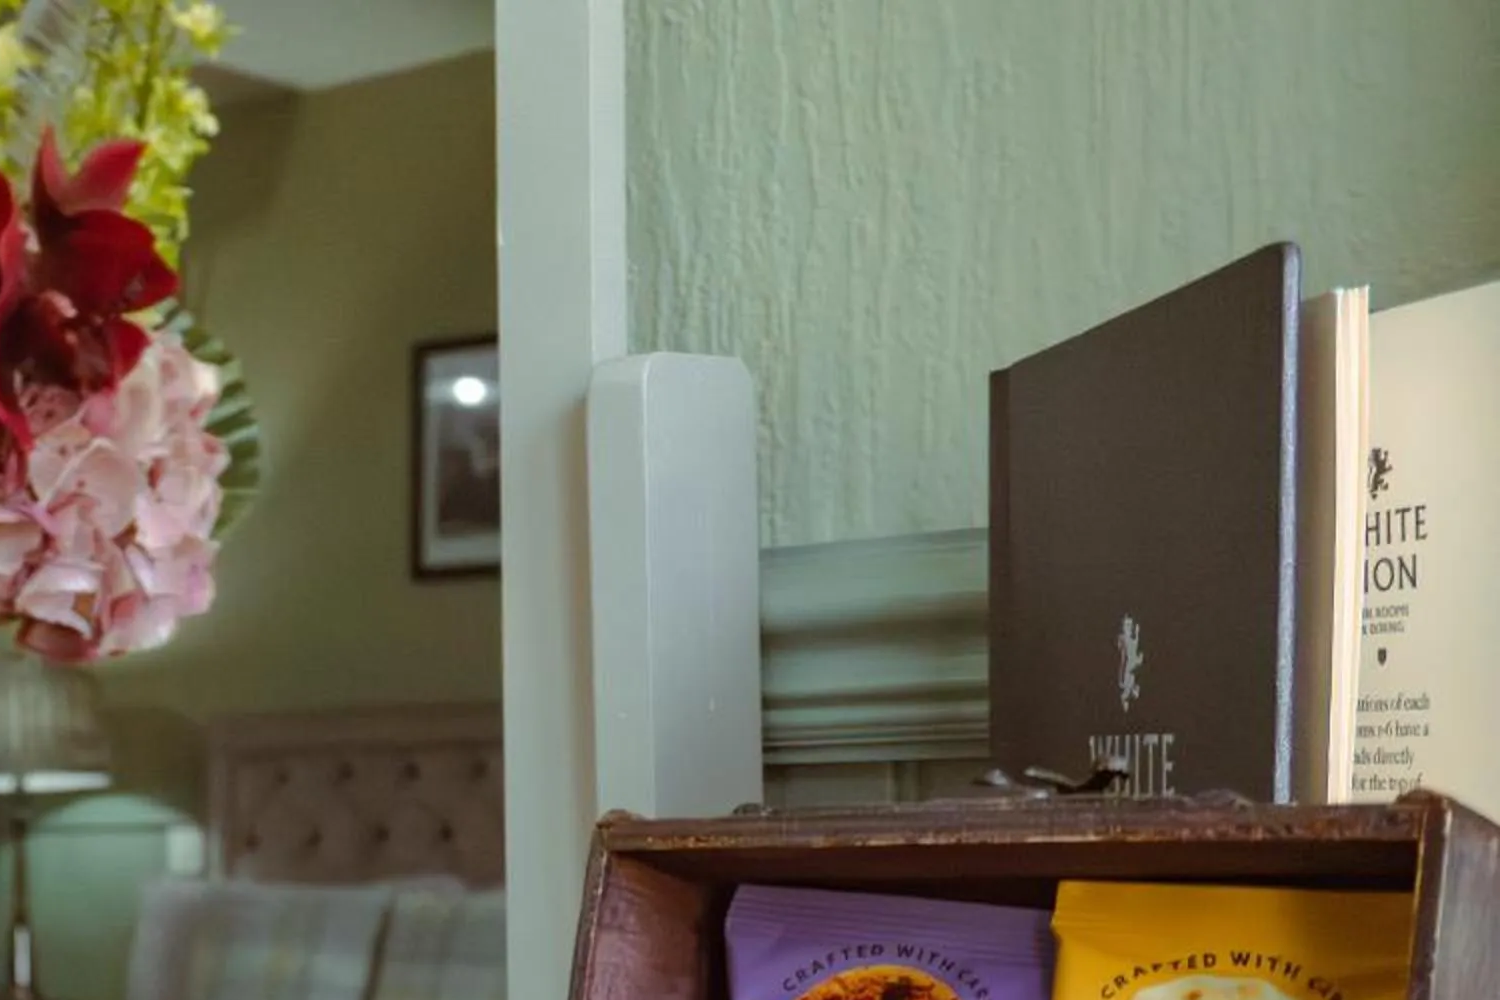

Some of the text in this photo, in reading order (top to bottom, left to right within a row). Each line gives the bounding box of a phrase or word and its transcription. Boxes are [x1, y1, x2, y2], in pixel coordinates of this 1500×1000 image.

[1364, 505, 1428, 547] HITE
[1363, 554, 1417, 594] ION
[1373, 746, 1414, 770] directly
[783, 944, 884, 992] CRAFTED
[897, 944, 956, 971] WITH
[1101, 953, 1217, 1000] CRAFTED
[1230, 950, 1302, 981] WITH
